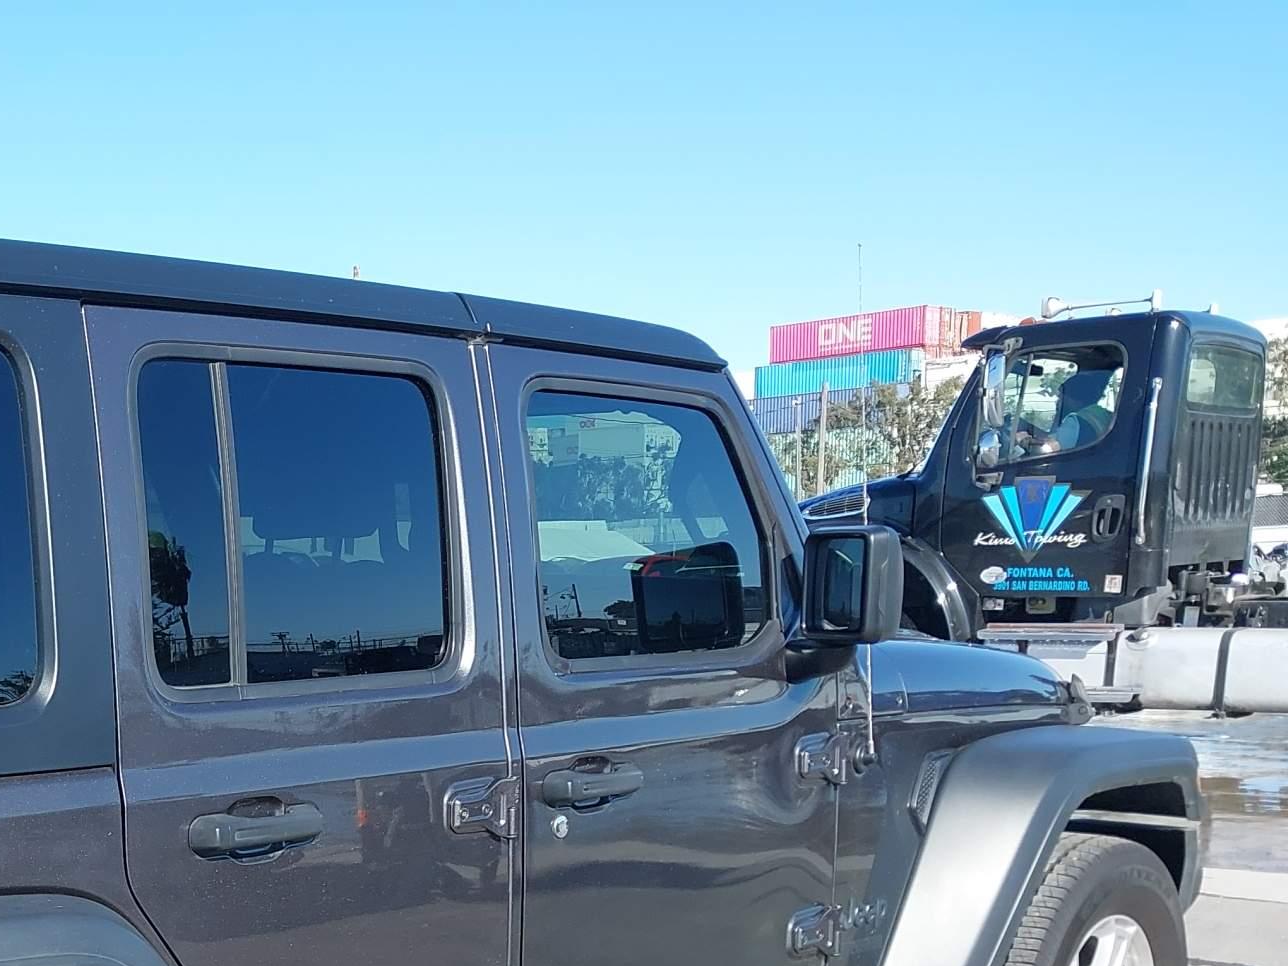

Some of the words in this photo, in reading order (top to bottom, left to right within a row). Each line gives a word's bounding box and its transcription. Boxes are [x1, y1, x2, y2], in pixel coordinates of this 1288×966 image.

[818, 317, 872, 345] ONE
[1023, 529, 1088, 549] Towing
[1006, 568, 1053, 577] FONTANA
[1012, 581, 1027, 590] SAN
[1029, 581, 1075, 590] BERNARDINO
